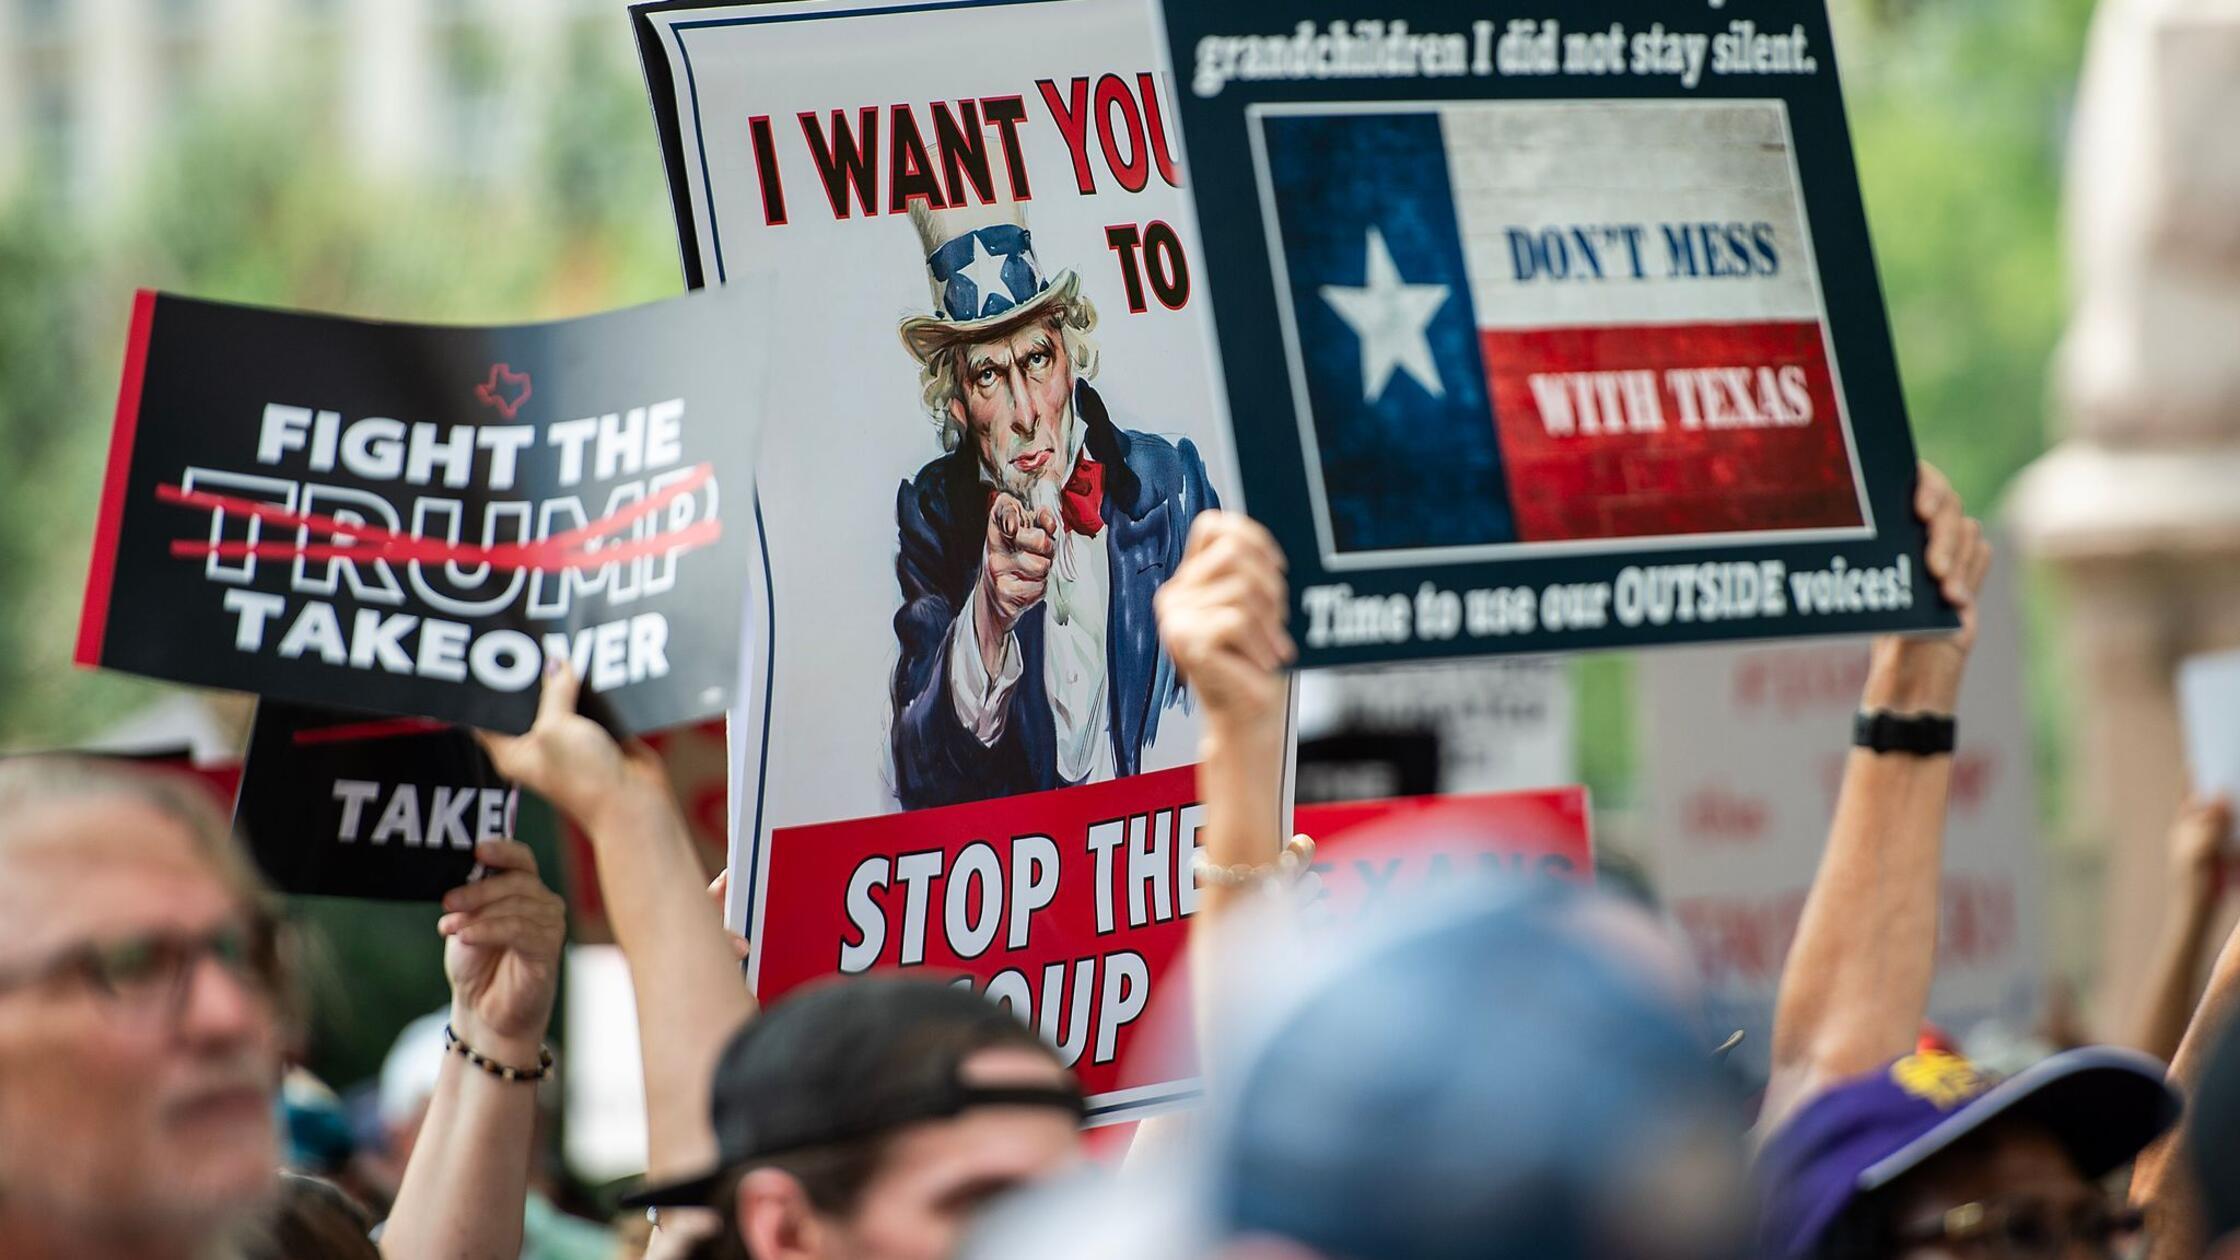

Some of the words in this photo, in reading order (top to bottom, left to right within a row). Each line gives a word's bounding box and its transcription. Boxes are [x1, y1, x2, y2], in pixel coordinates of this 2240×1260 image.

[1192, 19, 1469, 98] grandchildren
[1471, 19, 1496, 76] I
[1496, 18, 1560, 76] did
[1562, 22, 1627, 75] not
[1630, 22, 1708, 89] stay
[1711, 19, 1818, 74] silent.
[748, 115, 788, 227] I
[797, 94, 1032, 220] WANT
[1104, 219, 1191, 314] TO
[1505, 223, 1645, 281] DON'T
[1659, 221, 1779, 278] MESS
[257, 402, 535, 488] FIGHT
[547, 398, 685, 487] THE
[1527, 368, 1667, 438] WITH
[1664, 364, 1815, 431] TEXAS
[182, 463, 720, 620] TRUMP
[223, 589, 670, 693] TAKEOVER
[1302, 582, 1413, 648] Time
[1415, 580, 1463, 641] to
[1464, 585, 1537, 637] use
[1540, 581, 1613, 633] our
[1613, 559, 1787, 627] OUTSIDE
[1789, 553, 1913, 617] voices!
[332, 778, 519, 849] TAKE
[838, 832, 1062, 976] STOP
[1086, 800, 1208, 937] THE
[948, 949, 1150, 1070] OUP
